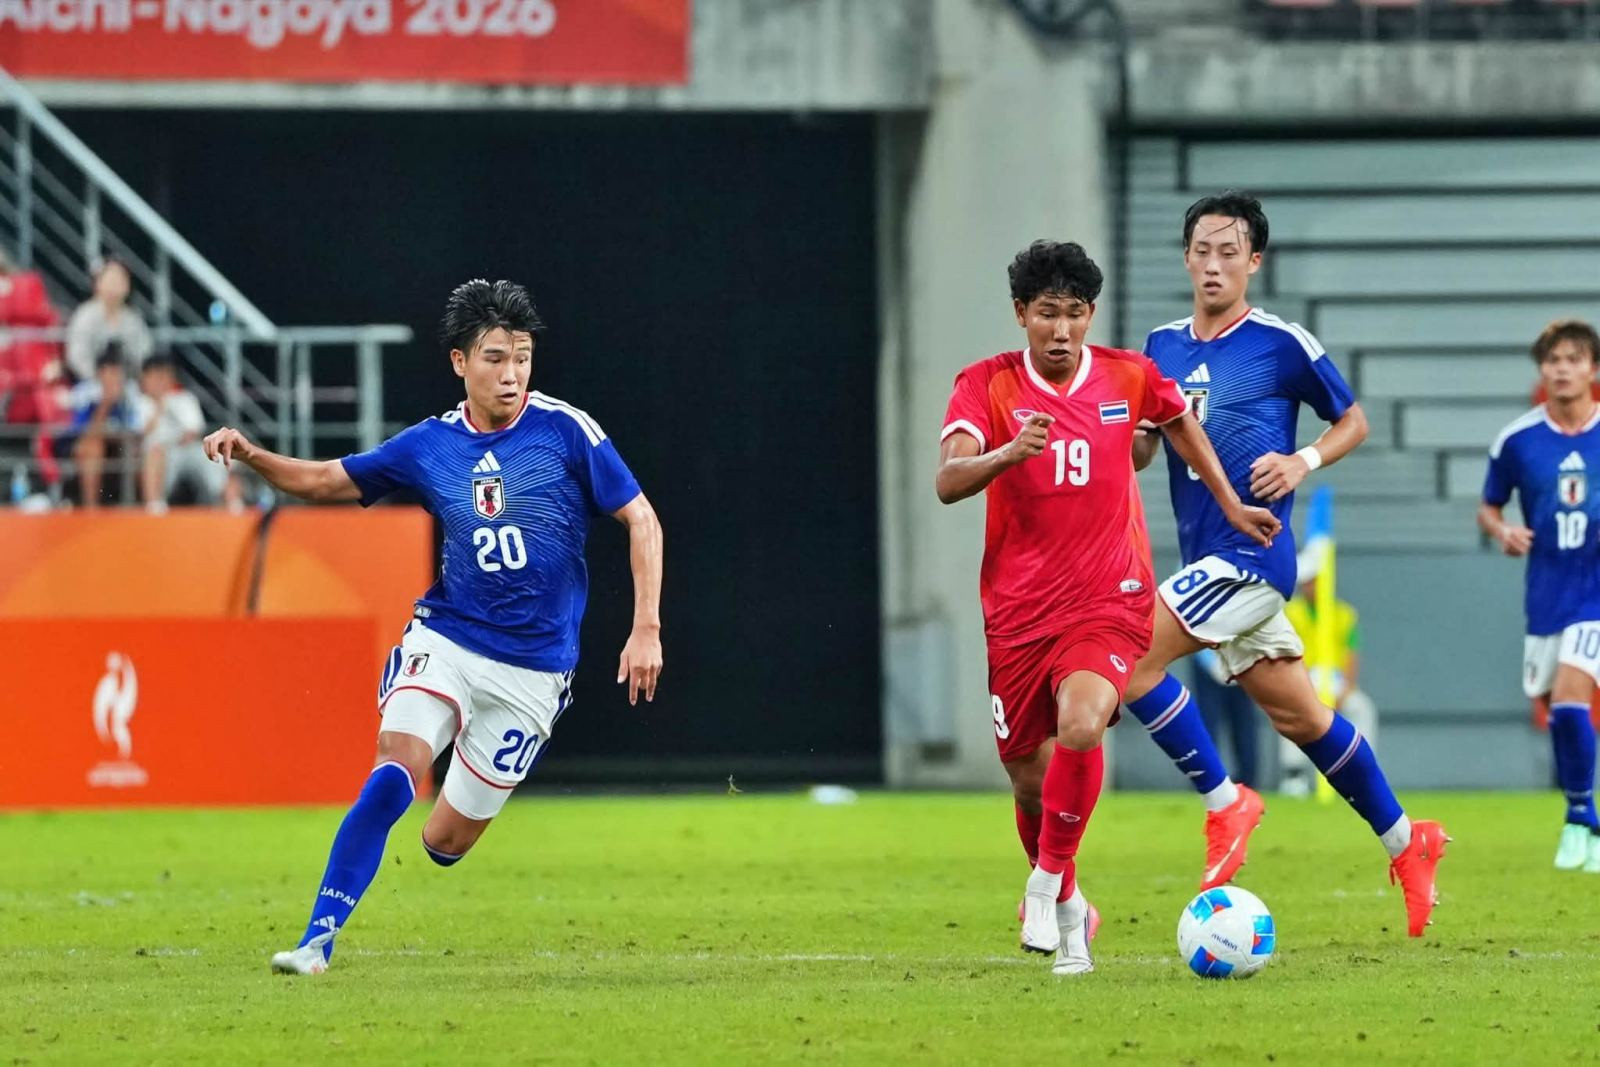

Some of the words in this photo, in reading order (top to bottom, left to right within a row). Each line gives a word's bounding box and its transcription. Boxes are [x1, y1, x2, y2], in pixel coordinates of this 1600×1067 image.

[404, 0, 556, 36] 2026
[1051, 439, 1090, 486] 19
[473, 525, 527, 572] 20
[1555, 510, 1588, 550] 10
[1172, 569, 1209, 595] 8
[1573, 628, 1600, 659] 10
[493, 729, 539, 774] 20
[320, 886, 357, 907] JAPAN
